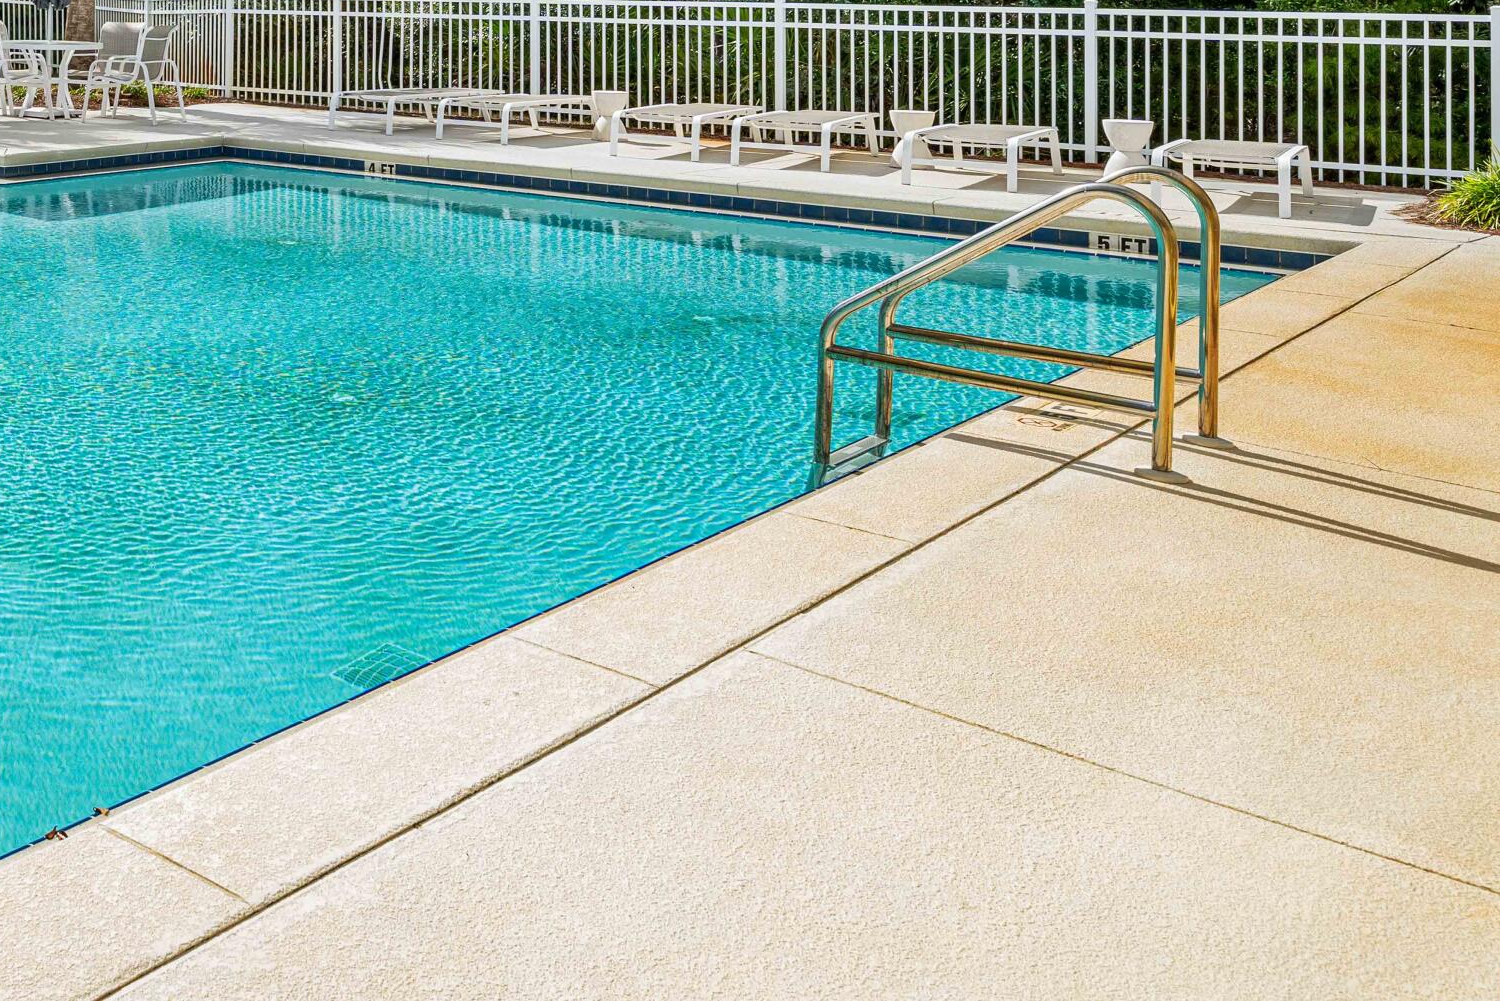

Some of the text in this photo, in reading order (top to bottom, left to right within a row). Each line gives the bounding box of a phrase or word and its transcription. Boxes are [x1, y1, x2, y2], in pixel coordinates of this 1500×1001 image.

[368, 162, 395, 175] 4 FT
[1098, 235, 1147, 253] 5 FT
